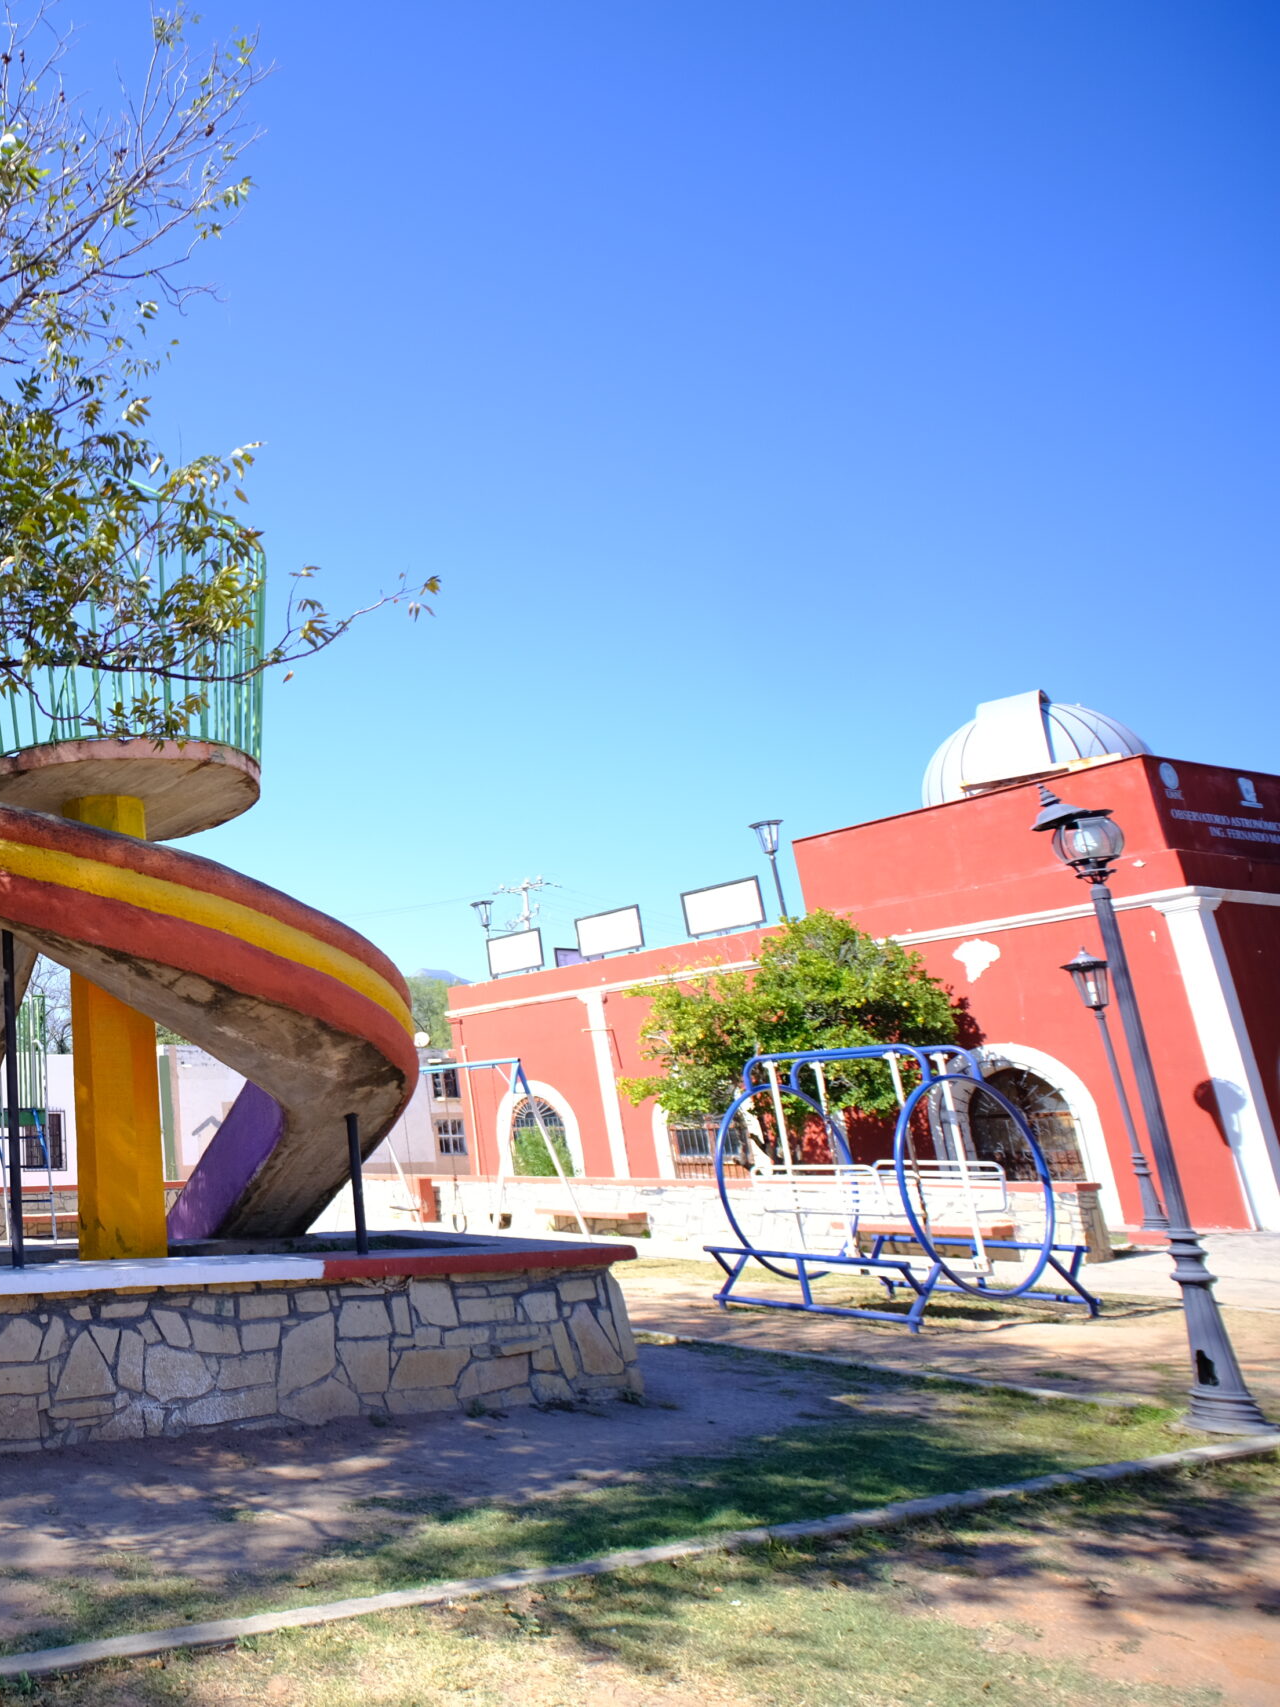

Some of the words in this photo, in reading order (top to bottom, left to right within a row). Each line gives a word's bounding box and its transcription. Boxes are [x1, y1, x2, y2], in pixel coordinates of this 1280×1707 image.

[1171, 809, 1230, 825] OBSERVATORIO
[1209, 826, 1227, 838] ING.
[1227, 829, 1269, 843] FERNANDO
